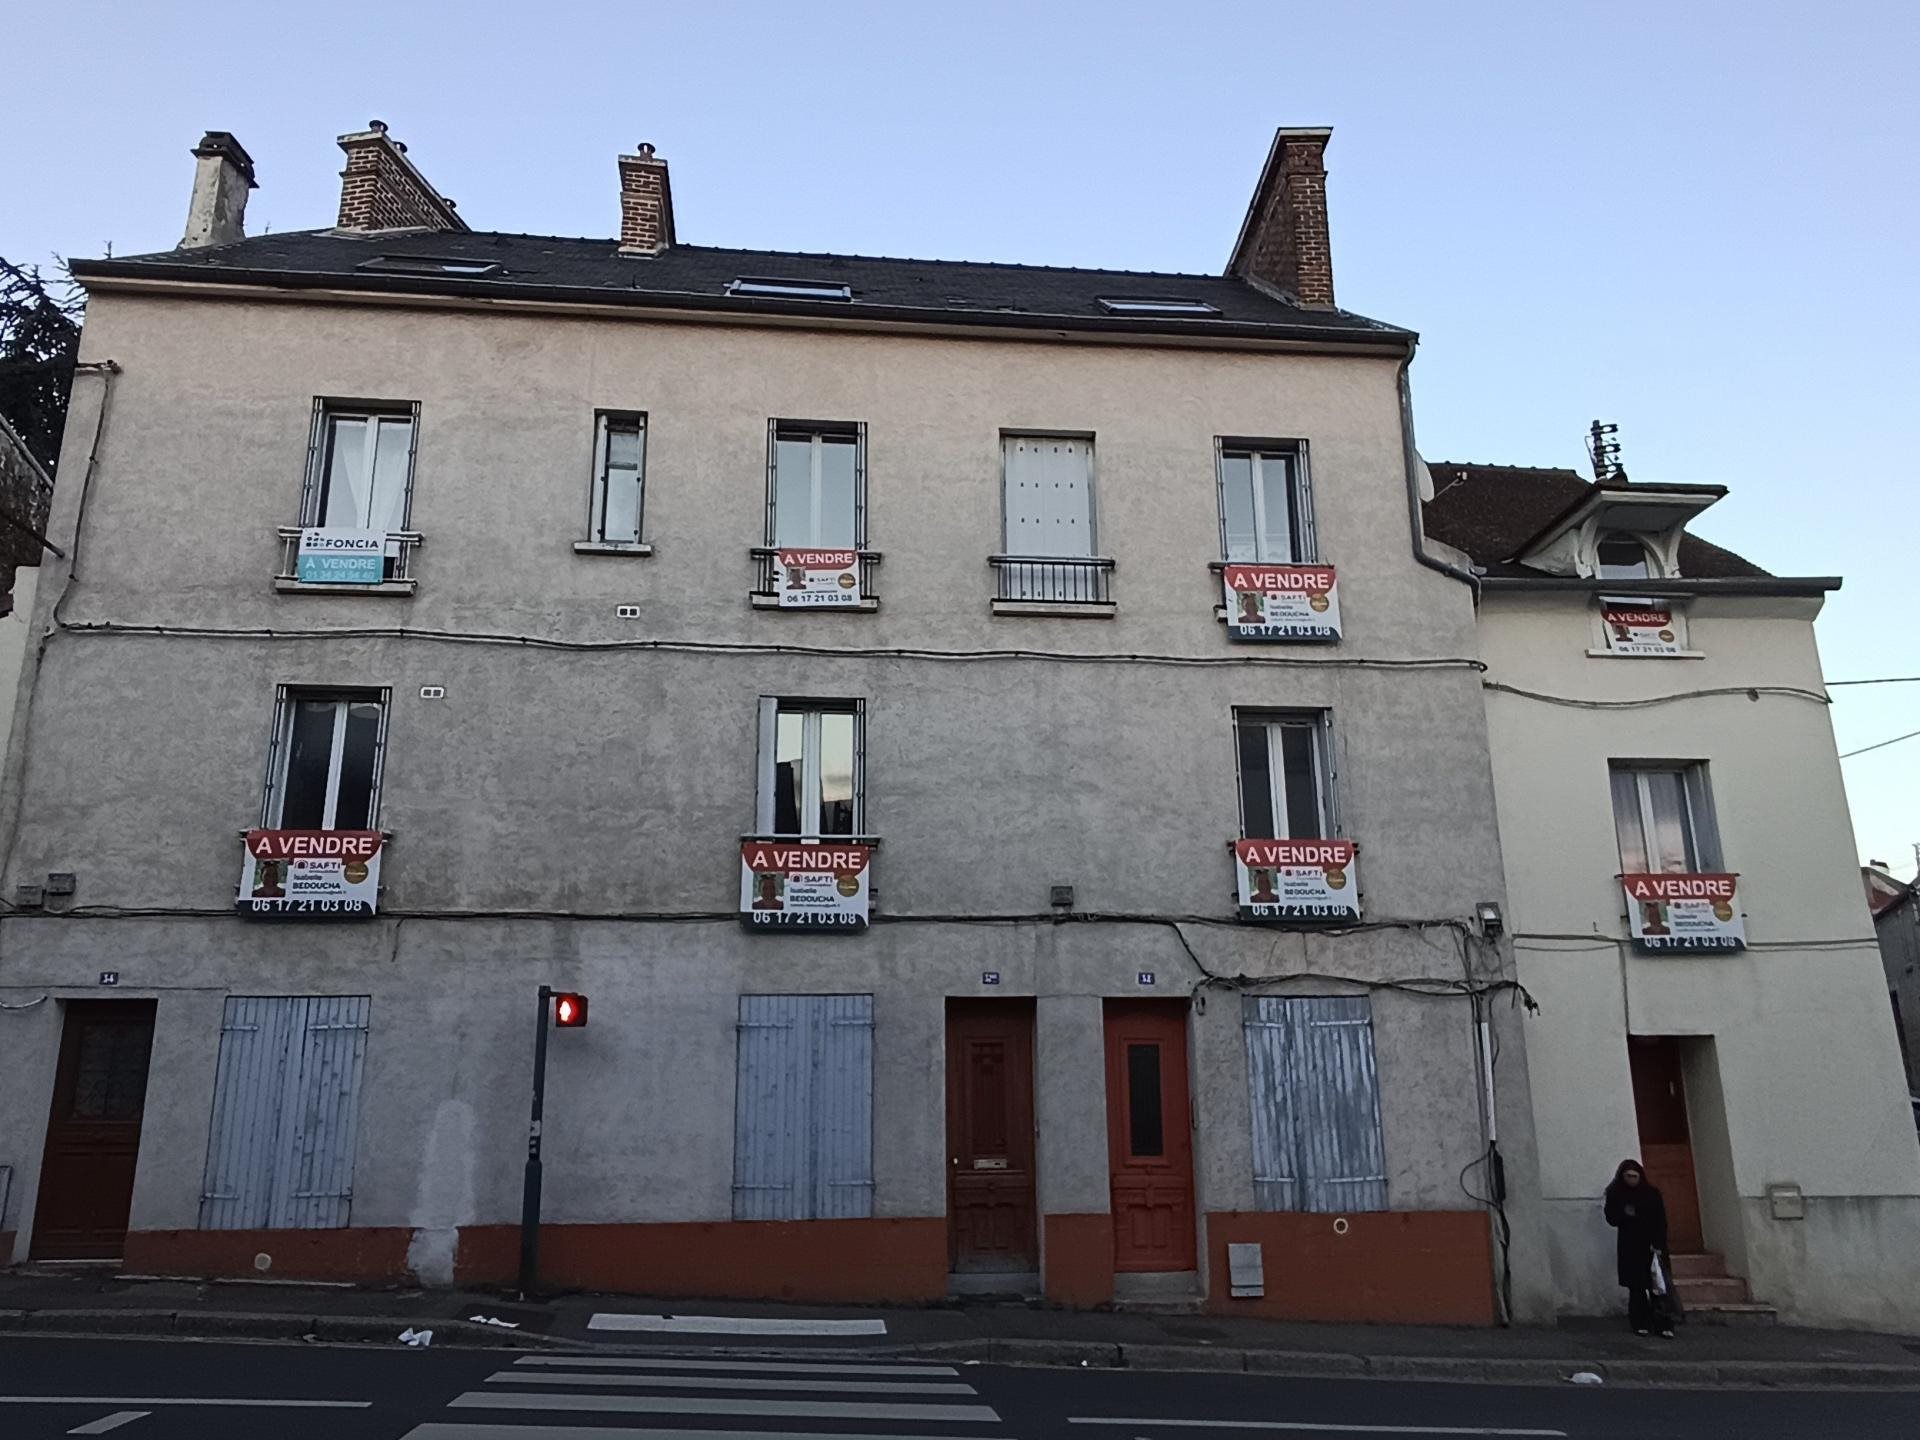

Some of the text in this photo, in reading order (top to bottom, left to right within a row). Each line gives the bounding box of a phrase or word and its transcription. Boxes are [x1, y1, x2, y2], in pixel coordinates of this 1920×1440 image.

[325, 539, 379, 548] FONCIA
[321, 558, 376, 570] VENDRE
[784, 552, 853, 565] A VENDRE
[1233, 572, 1330, 589] A VENDRE
[786, 594, 853, 602] 06 17 21 03 08
[1607, 613, 1667, 622] A VENDRE
[1240, 625, 1331, 635] 06 17 21 03 08
[255, 836, 373, 855] A VENDRE
[752, 850, 861, 869] A VENDRE
[1246, 846, 1347, 863] A VENDRE
[1635, 880, 1732, 896] A VENDRE
[252, 900, 362, 911] 06 17 21 03 08
[1252, 905, 1348, 916] 06 17 21 03 08
[753, 912, 857, 924] 06 17 21 03 08
[1644, 936, 1736, 947] 06 17 21 03 08
